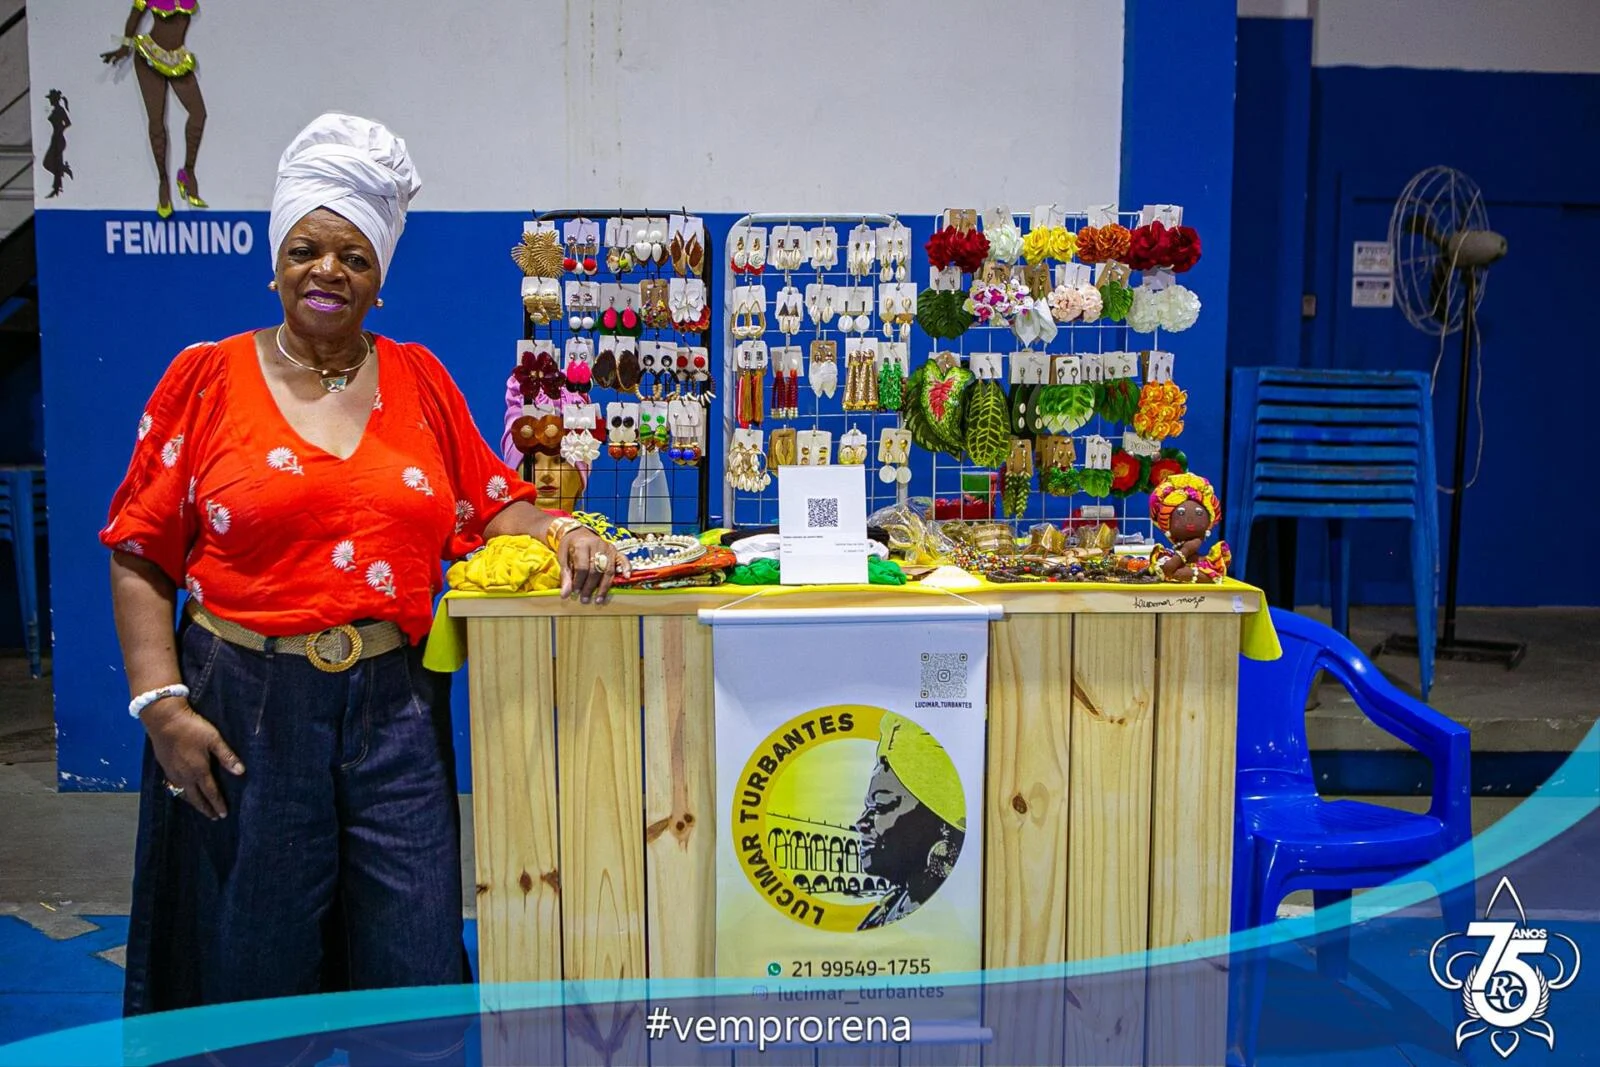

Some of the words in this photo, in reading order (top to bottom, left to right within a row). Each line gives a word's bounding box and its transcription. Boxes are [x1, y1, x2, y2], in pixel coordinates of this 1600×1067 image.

[105, 220, 254, 255] FEMININO
[914, 701, 973, 709] LUCIMAR_TURBANTES
[740, 713, 855, 824] TURBANTES
[741, 833, 825, 926] LUCIMAR
[791, 961, 813, 978] 21
[821, 958, 931, 977] 99549-1755
